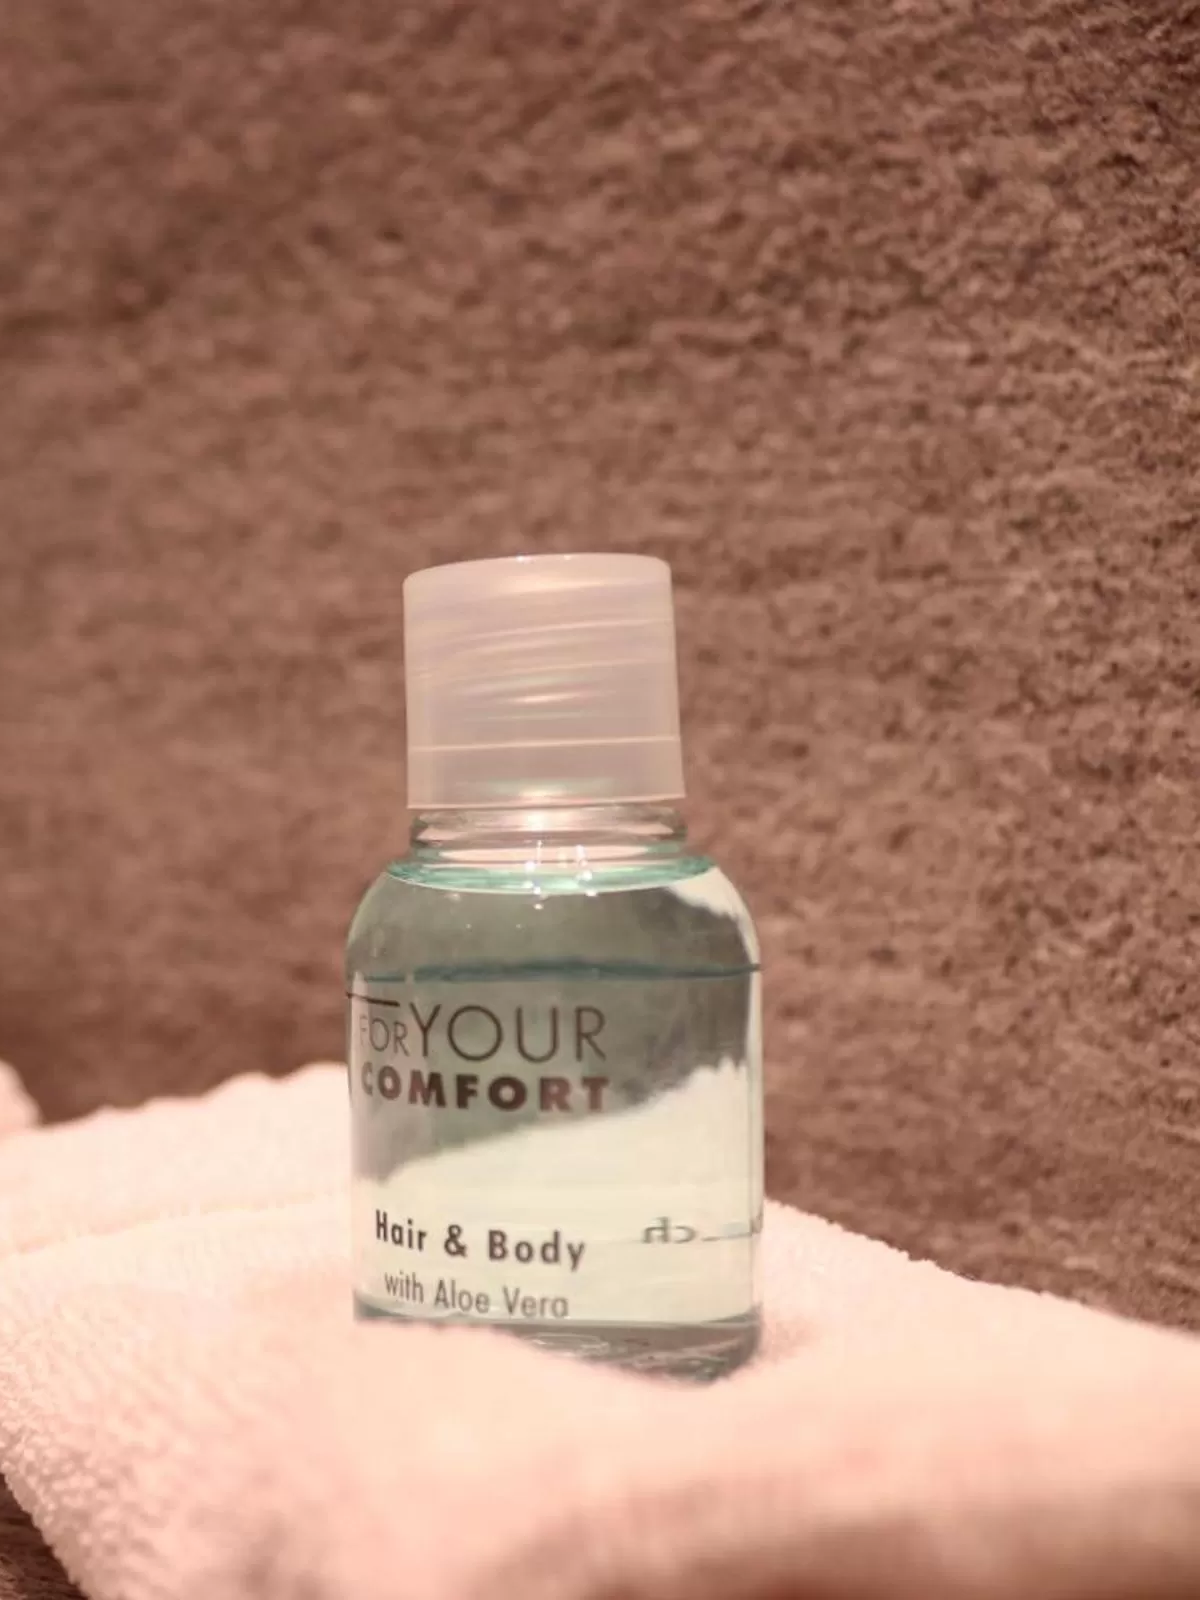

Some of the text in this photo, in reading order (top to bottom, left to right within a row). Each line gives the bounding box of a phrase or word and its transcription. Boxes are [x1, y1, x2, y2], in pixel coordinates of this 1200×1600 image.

[361, 1062, 610, 1113] COMFORT
[375, 1208, 585, 1273] Hair & Body
[384, 1270, 569, 1319] with Aloe Vera
